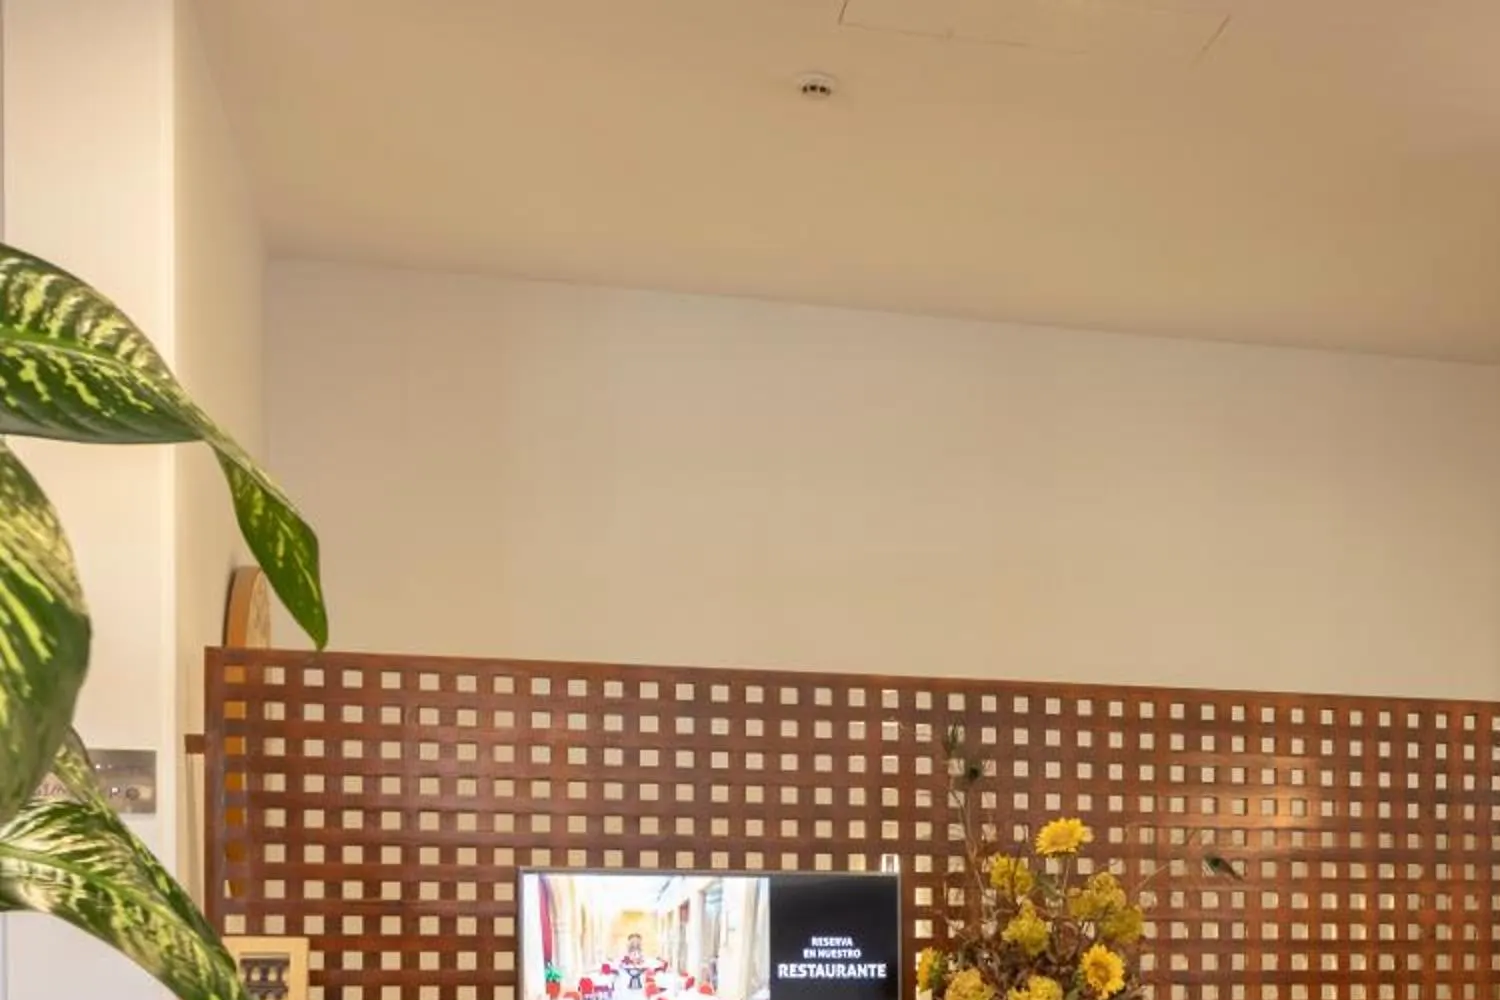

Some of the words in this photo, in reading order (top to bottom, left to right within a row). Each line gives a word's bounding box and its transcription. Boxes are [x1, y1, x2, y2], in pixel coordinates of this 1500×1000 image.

[811, 936, 853, 947] RESERVA
[803, 948, 817, 959] EN
[818, 948, 862, 959] NUESTRO
[778, 963, 887, 979] RESTAURANTE
